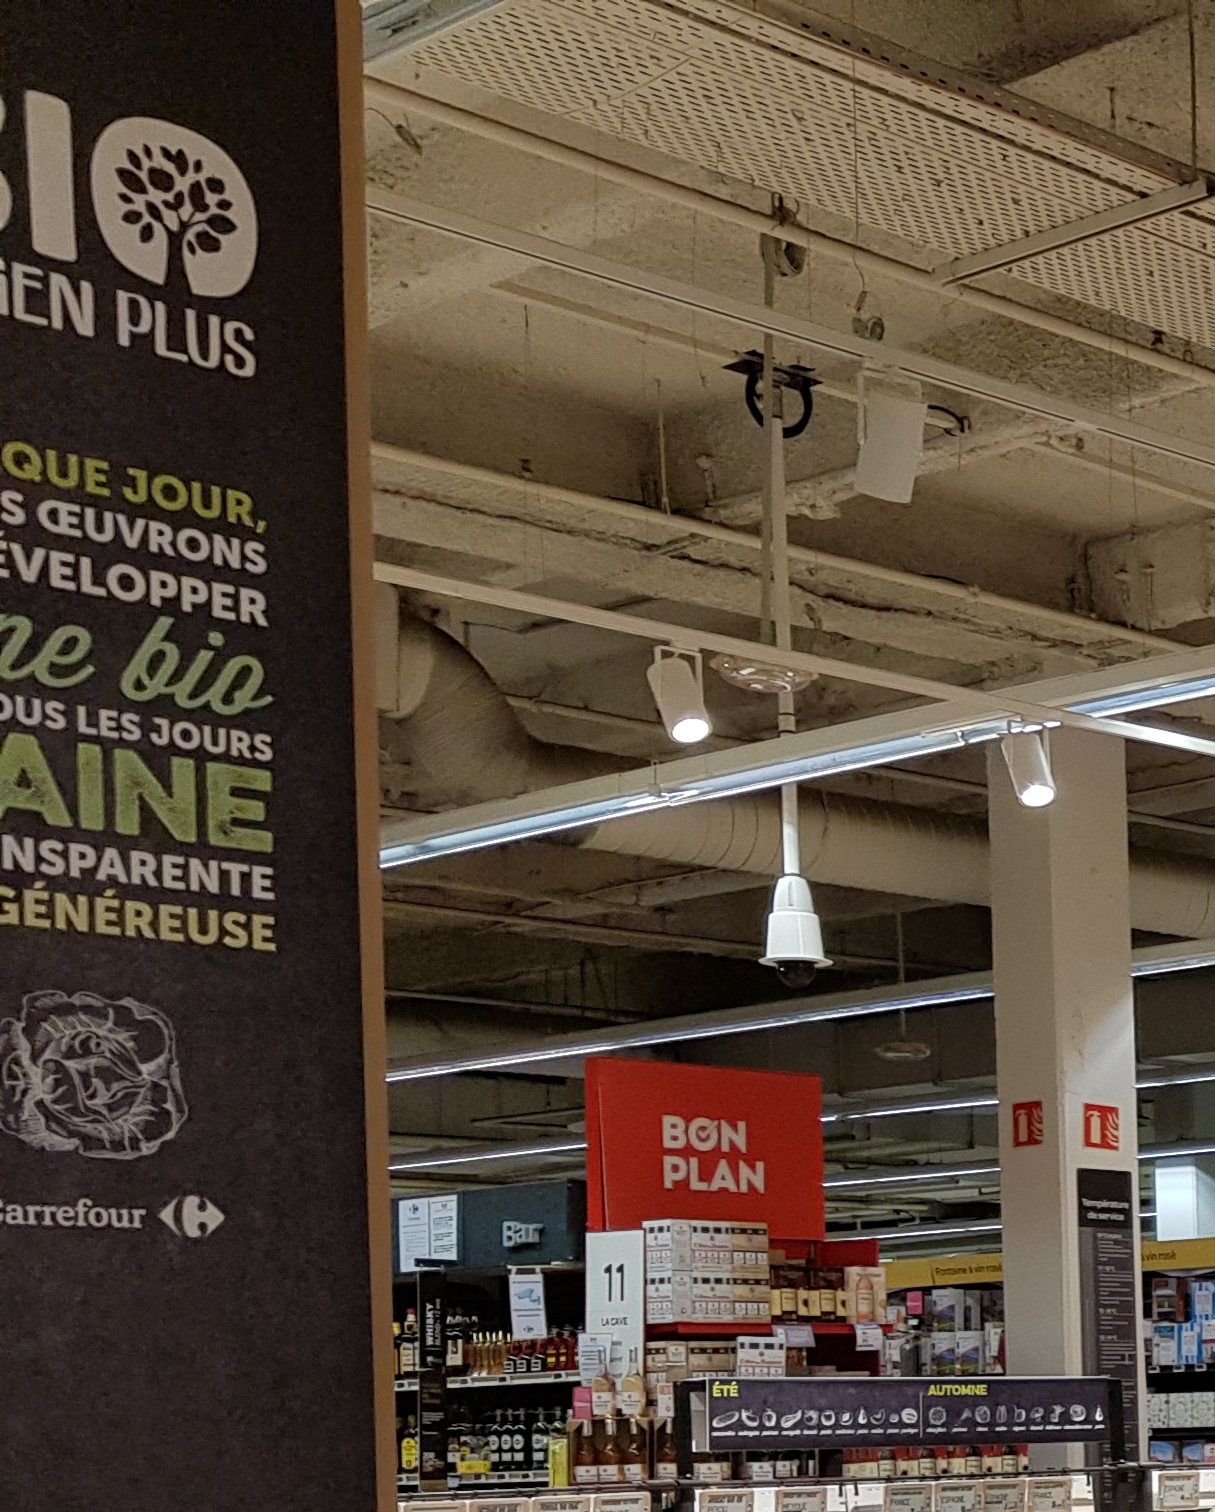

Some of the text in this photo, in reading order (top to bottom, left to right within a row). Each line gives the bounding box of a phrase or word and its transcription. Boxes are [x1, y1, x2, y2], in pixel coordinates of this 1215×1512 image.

[0, 89, 258, 298] IO
[115, 289, 257, 378] PLUS
[1, 441, 268, 533] QUE JOUR,
[36, 499, 268, 574] ŒUVRONS
[120, 616, 274, 715] bio
[77, 704, 142, 741] LES
[150, 716, 274, 762] JOURS
[1, 834, 275, 900] NSPARENTE
[661, 1114, 747, 1154] BON
[662, 1155, 765, 1194] PLAN
[603, 1263, 625, 1302] 11
[425, 1302, 434, 1346] WHISKY
[712, 1381, 739, 1397] ÉTÉ
[927, 1384, 988, 1397] AUTOMNE
